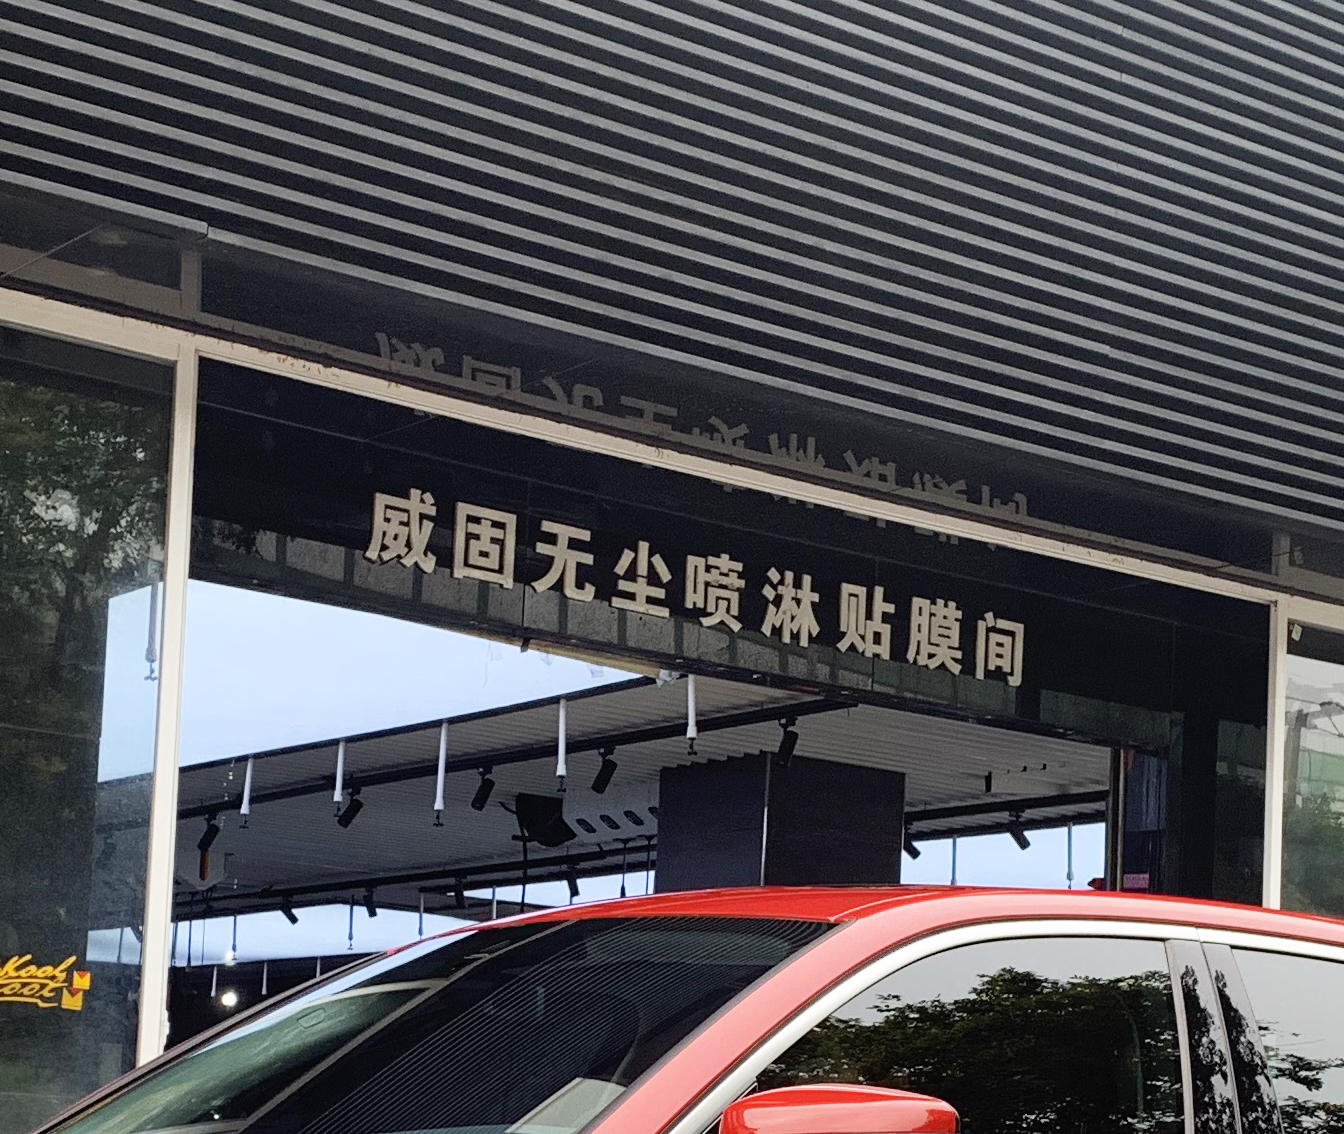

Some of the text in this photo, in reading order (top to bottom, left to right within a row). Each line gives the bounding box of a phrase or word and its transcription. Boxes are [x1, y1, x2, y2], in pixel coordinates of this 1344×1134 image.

[364, 487, 1024, 687] 威固无尘喷淋贴膜间
